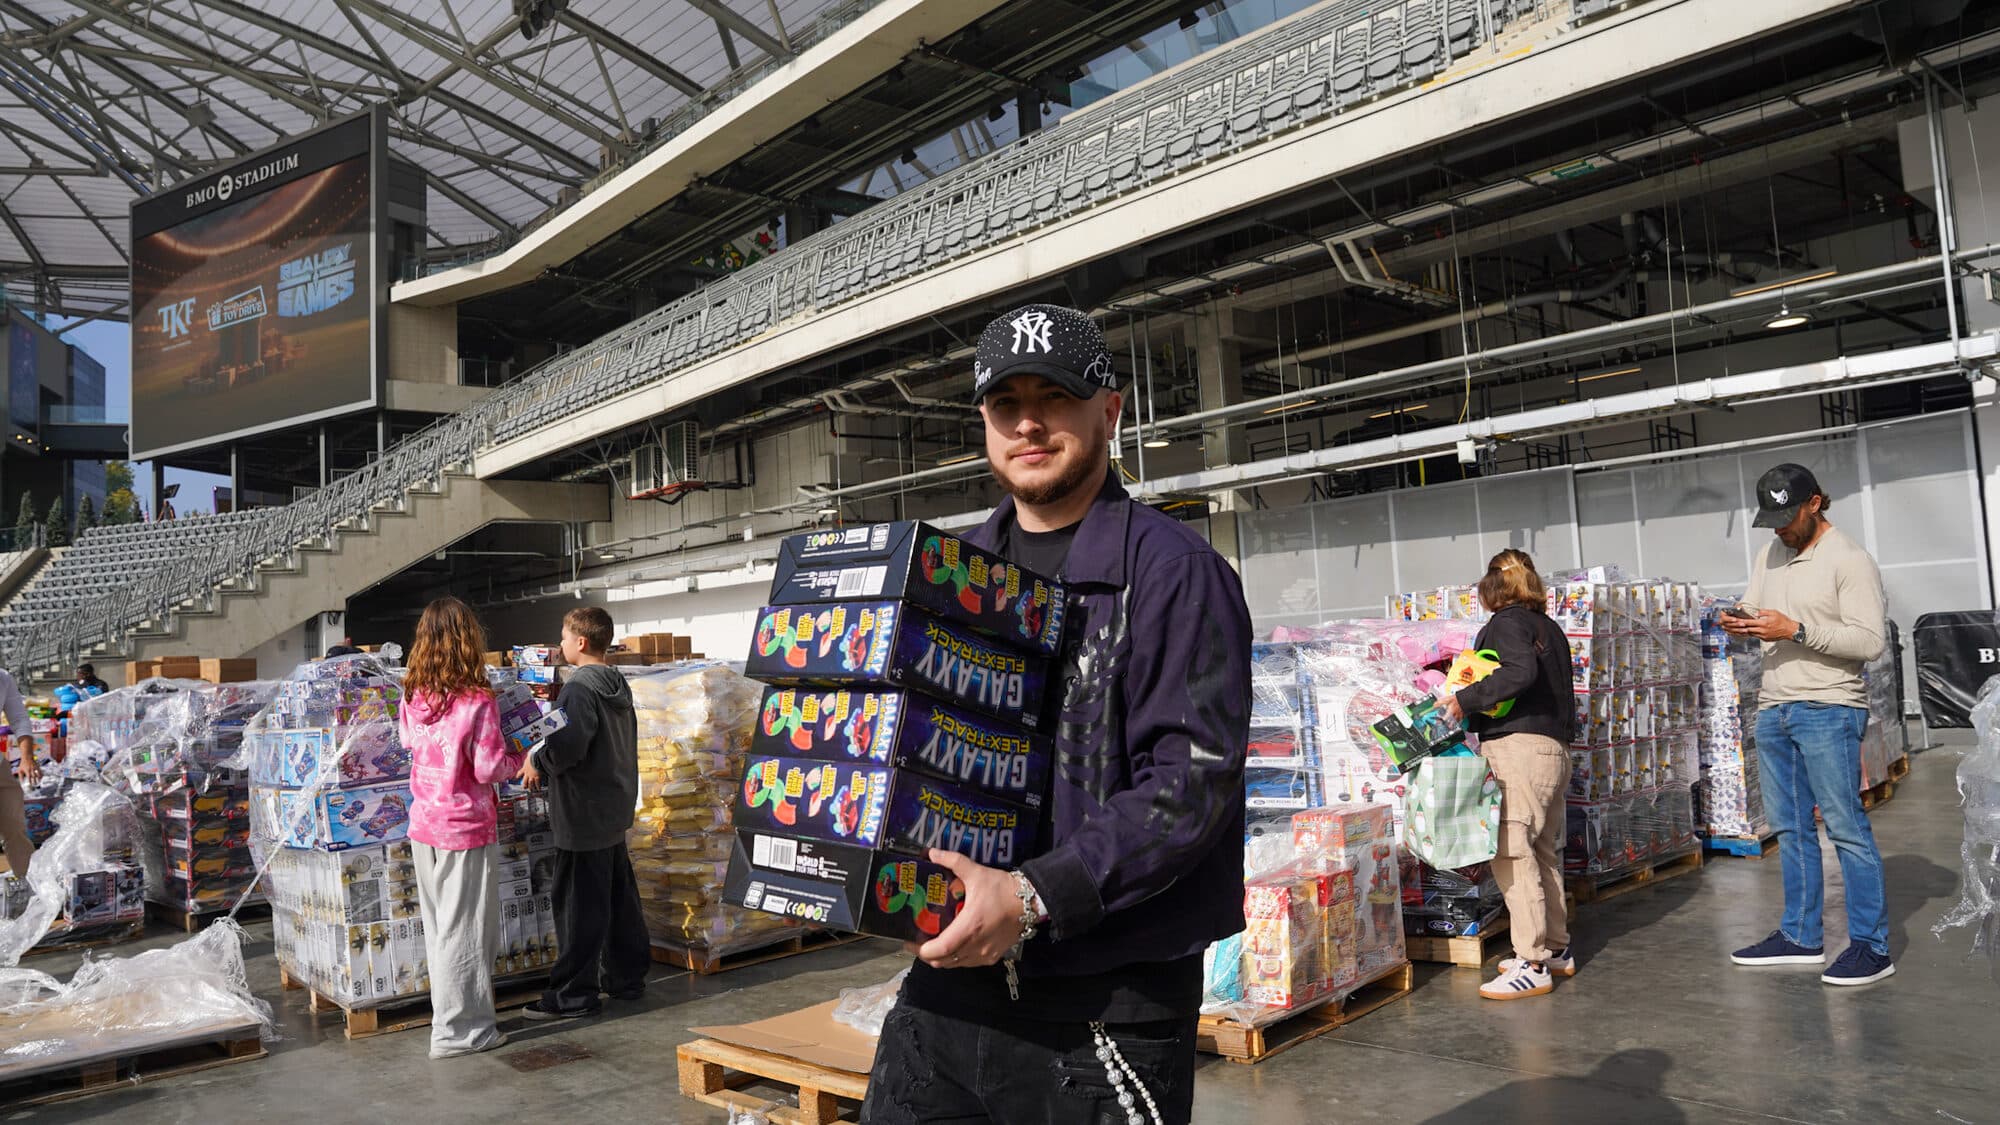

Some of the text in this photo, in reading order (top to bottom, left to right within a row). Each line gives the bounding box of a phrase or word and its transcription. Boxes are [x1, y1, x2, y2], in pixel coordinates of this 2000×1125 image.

[186, 153, 300, 208] BMO STADIUM
[158, 297, 197, 339] TKF
[223, 309, 238, 322] TOY
[238, 300, 262, 318] DRIVE
[277, 271, 355, 317] GAMES
[1011, 311, 1054, 355] NY
[871, 606, 895, 674] GALAXY
[1046, 587, 1064, 651] GALAXY
[925, 622, 1025, 672] FLEX-TRACK
[914, 641, 1023, 708] GALAXY
[876, 693, 898, 761] GALAXY
[929, 708, 1030, 753] FLEX-TRACK
[919, 728, 1027, 789] GALAXY
[863, 771, 888, 842] GALAXY
[917, 786, 1017, 828] FLEX-TRACK
